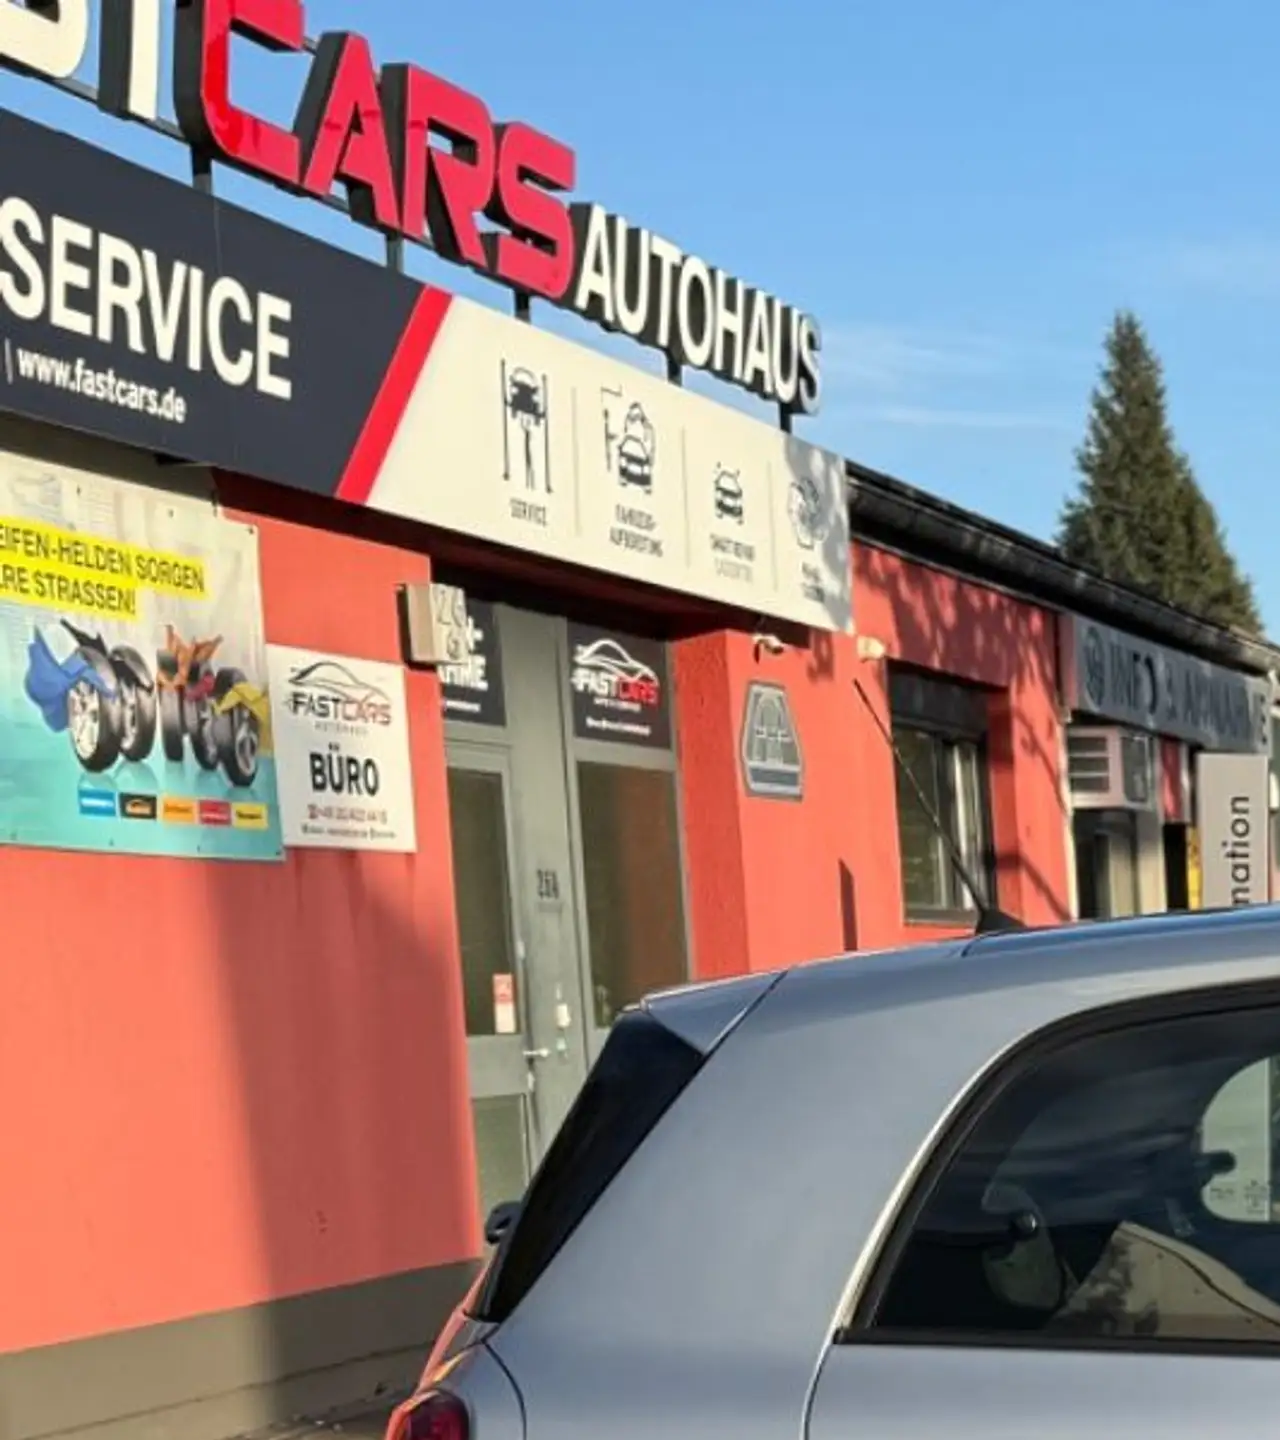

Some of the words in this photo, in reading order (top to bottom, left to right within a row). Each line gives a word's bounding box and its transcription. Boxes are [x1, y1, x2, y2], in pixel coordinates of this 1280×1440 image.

[0, 197, 292, 400] SERVICE
[577, 204, 821, 411] AUTOHAUS
[17, 348, 187, 424] www.fastcars.de
[33, 569, 136, 615] STRASSEN!
[135, 554, 205, 593] SORGEN
[287, 692, 392, 727] FASTCARS
[309, 741, 380, 797] BÜRO
